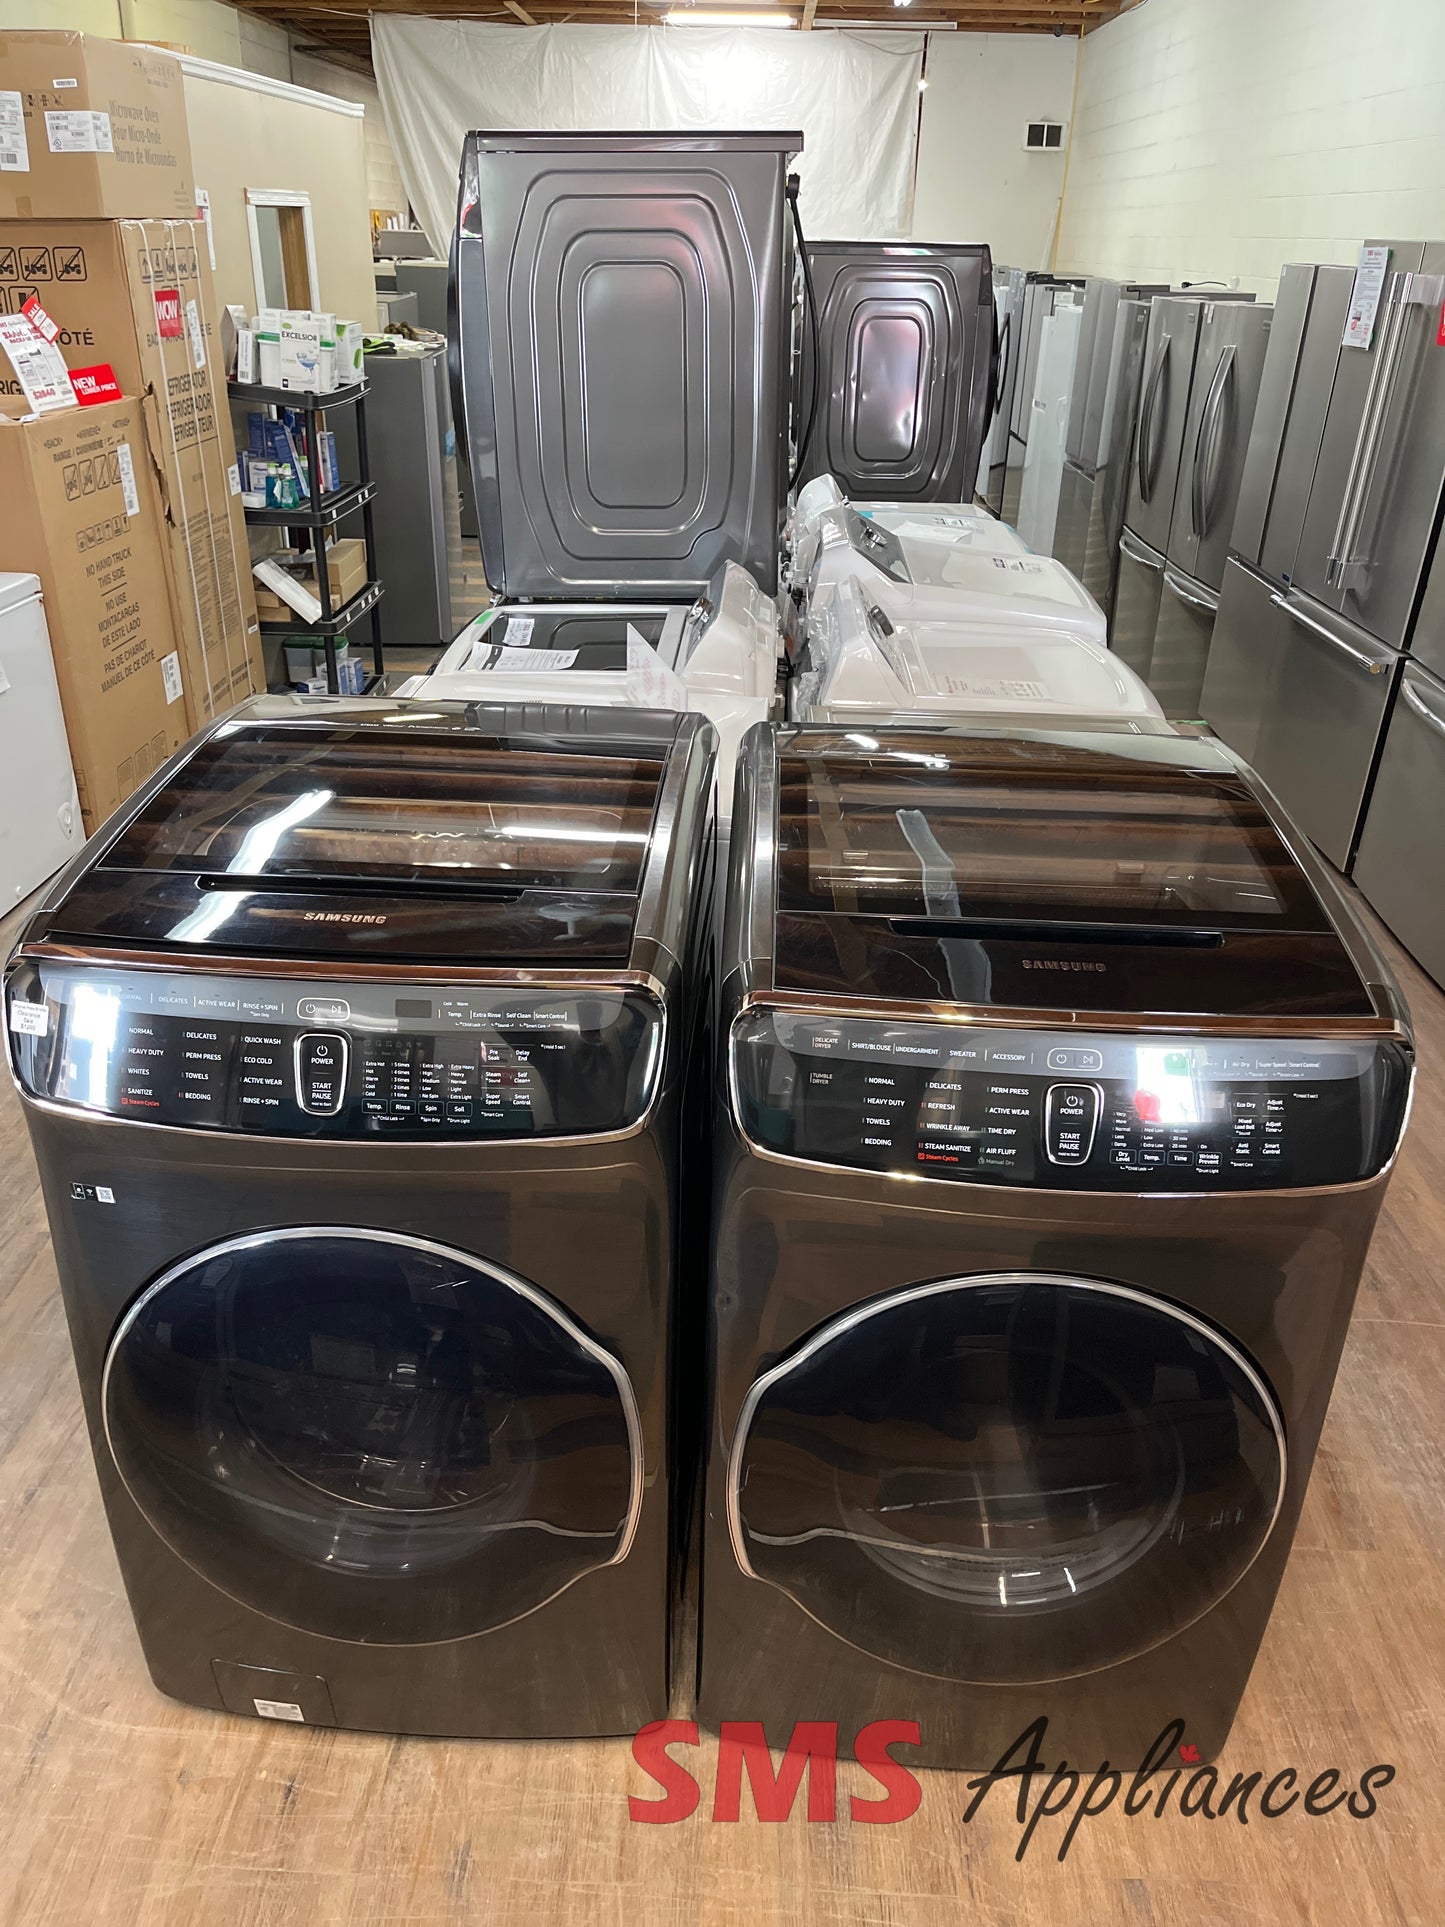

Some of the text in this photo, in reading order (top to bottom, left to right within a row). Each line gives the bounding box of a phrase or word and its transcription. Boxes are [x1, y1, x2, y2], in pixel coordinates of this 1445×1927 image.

[109, 100, 160, 123] Microwave Oven
[136, 148, 143, 164] de
[28, 303, 40, 318] SALE
[156, 300, 178, 320] WOW
[57, 328, 95, 346] ÔTÉ
[281, 331, 318, 342] EXCELSIOR
[73, 376, 96, 391] NEW
[82, 383, 118, 396] LOWER PRICE
[86, 547, 132, 577] NO HAND TRUCK
[98, 567, 126, 588] THIS SIDE
[105, 592, 127, 612] NO USE
[98, 602, 140, 632] MONTACARGAS
[102, 617, 141, 648] DE ESTE LADO
[104, 639, 148, 674] PAS DE CHARIOT
[101, 674, 125, 693] MANUEL
[124, 665, 133, 681] DE
[132, 659, 141, 673] CE
[303, 912, 387, 924] SAMSUNG
[1021, 959, 1106, 972] SAMSUNG
[158, 996, 189, 1004] DELICATES
[129, 1027, 154, 1035] NORMAL
[186, 1032, 217, 1040] DELICATES
[244, 1036, 281, 1045] QUICK WASH
[851, 1043, 892, 1052] SHIRT/BLOUSE
[896, 1047, 939, 1055] UNDERGARMENT
[186, 1052, 221, 1061] PERM PRESS
[515, 1049, 530, 1057] Delay
[949, 1050, 976, 1058] SWEATER
[992, 1053, 1026, 1062] ACCESSORY
[127, 1067, 150, 1075] WHITES
[185, 1072, 209, 1080] TOWELS
[243, 1077, 262, 1085] ACTIVE
[868, 1077, 895, 1086] NORMAL
[929, 1082, 962, 1091] DELICATES
[127, 1088, 153, 1096] SANITIZE
[991, 1087, 1029, 1096] PERM PRESS
[185, 1092, 211, 1101] BEDDING
[312, 1093, 332, 1101] PAUSE
[243, 1097, 261, 1105] RINSE
[266, 1098, 279, 1106] SPIN
[867, 1098, 905, 1107] HEAVY DUTY
[367, 1103, 383, 1111] Temp.
[395, 1104, 411, 1112] Rinse
[425, 1105, 438, 1113] Spin
[927, 1102, 955, 1111] REFRESH
[989, 1107, 1030, 1117] ACTIVE WEAR
[1060, 1107, 1084, 1116] POWER
[866, 1118, 891, 1126] TOWELS
[926, 1122, 971, 1132] WRINKLE AWAY
[988, 1127, 1017, 1136] TIME DRY
[1060, 1132, 1081, 1140] START
[864, 1138, 892, 1146] BEDDING
[1059, 1142, 1080, 1151] PAUSE
[924, 1142, 972, 1153] STEAM SANITIZE
[997, 1148, 1017, 1156] FLUFF
[1144, 1154, 1160, 1162] Temp.
[1005, 1159, 1015, 1167] Dry
